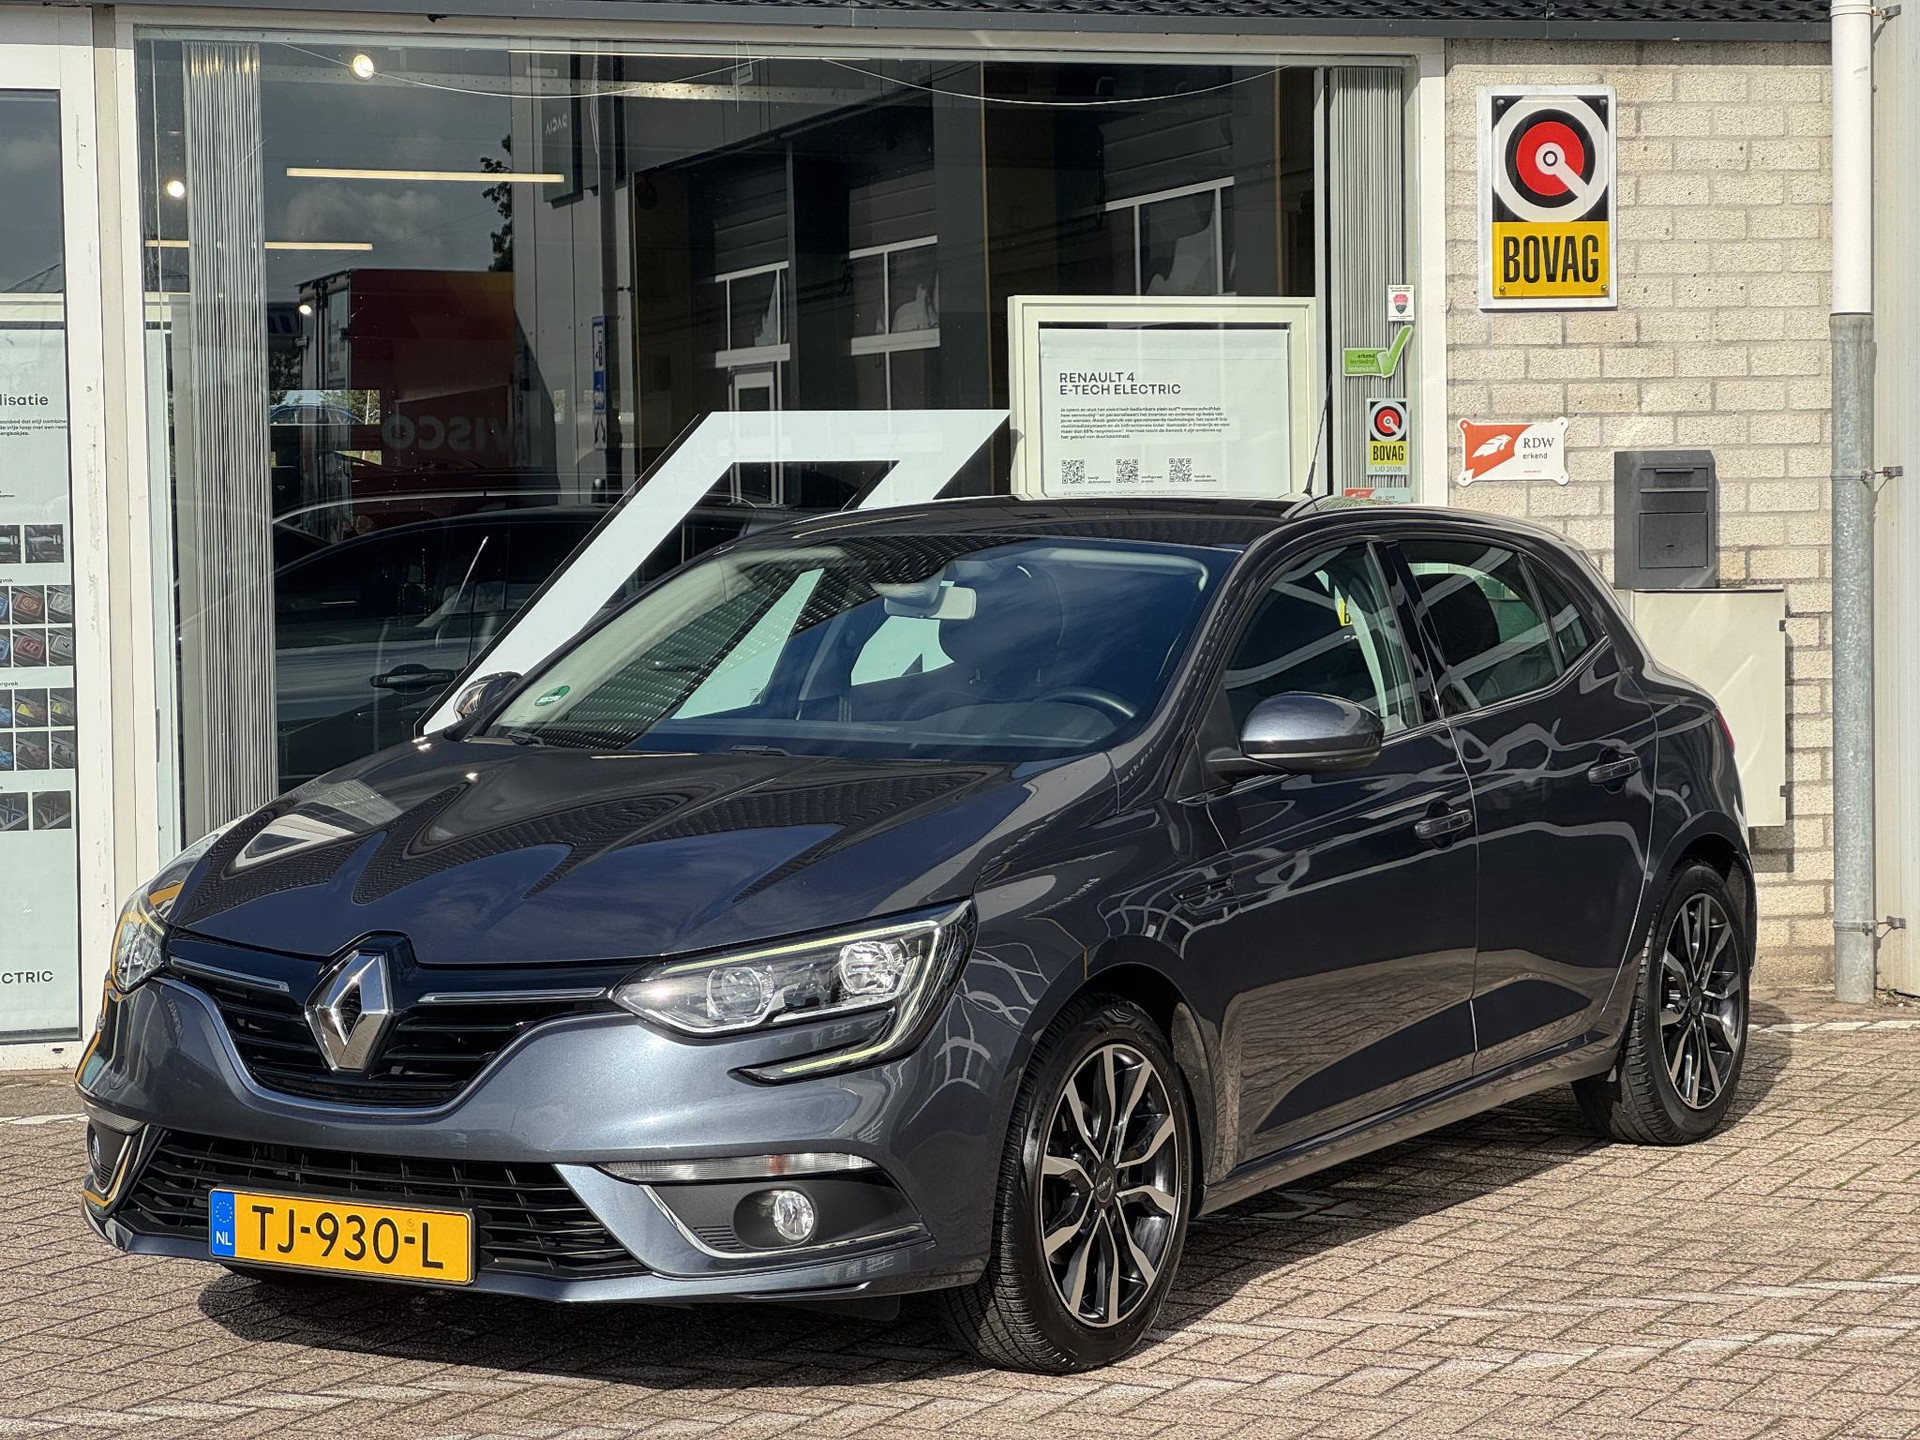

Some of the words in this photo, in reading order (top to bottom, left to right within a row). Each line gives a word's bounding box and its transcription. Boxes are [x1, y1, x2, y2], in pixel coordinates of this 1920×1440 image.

[1503, 234, 1599, 283] BOVAG
[1059, 372, 1124, 384] RENAULT
[1126, 372, 1135, 382] 4
[1059, 384, 1110, 395] E-TECH
[1114, 384, 1182, 395] ELECTRIC
[1523, 438, 1554, 449] RDW
[1373, 446, 1404, 461] BOVAG
[216, 1230, 232, 1246] NL
[251, 1205, 444, 1270] TJ-930-L
